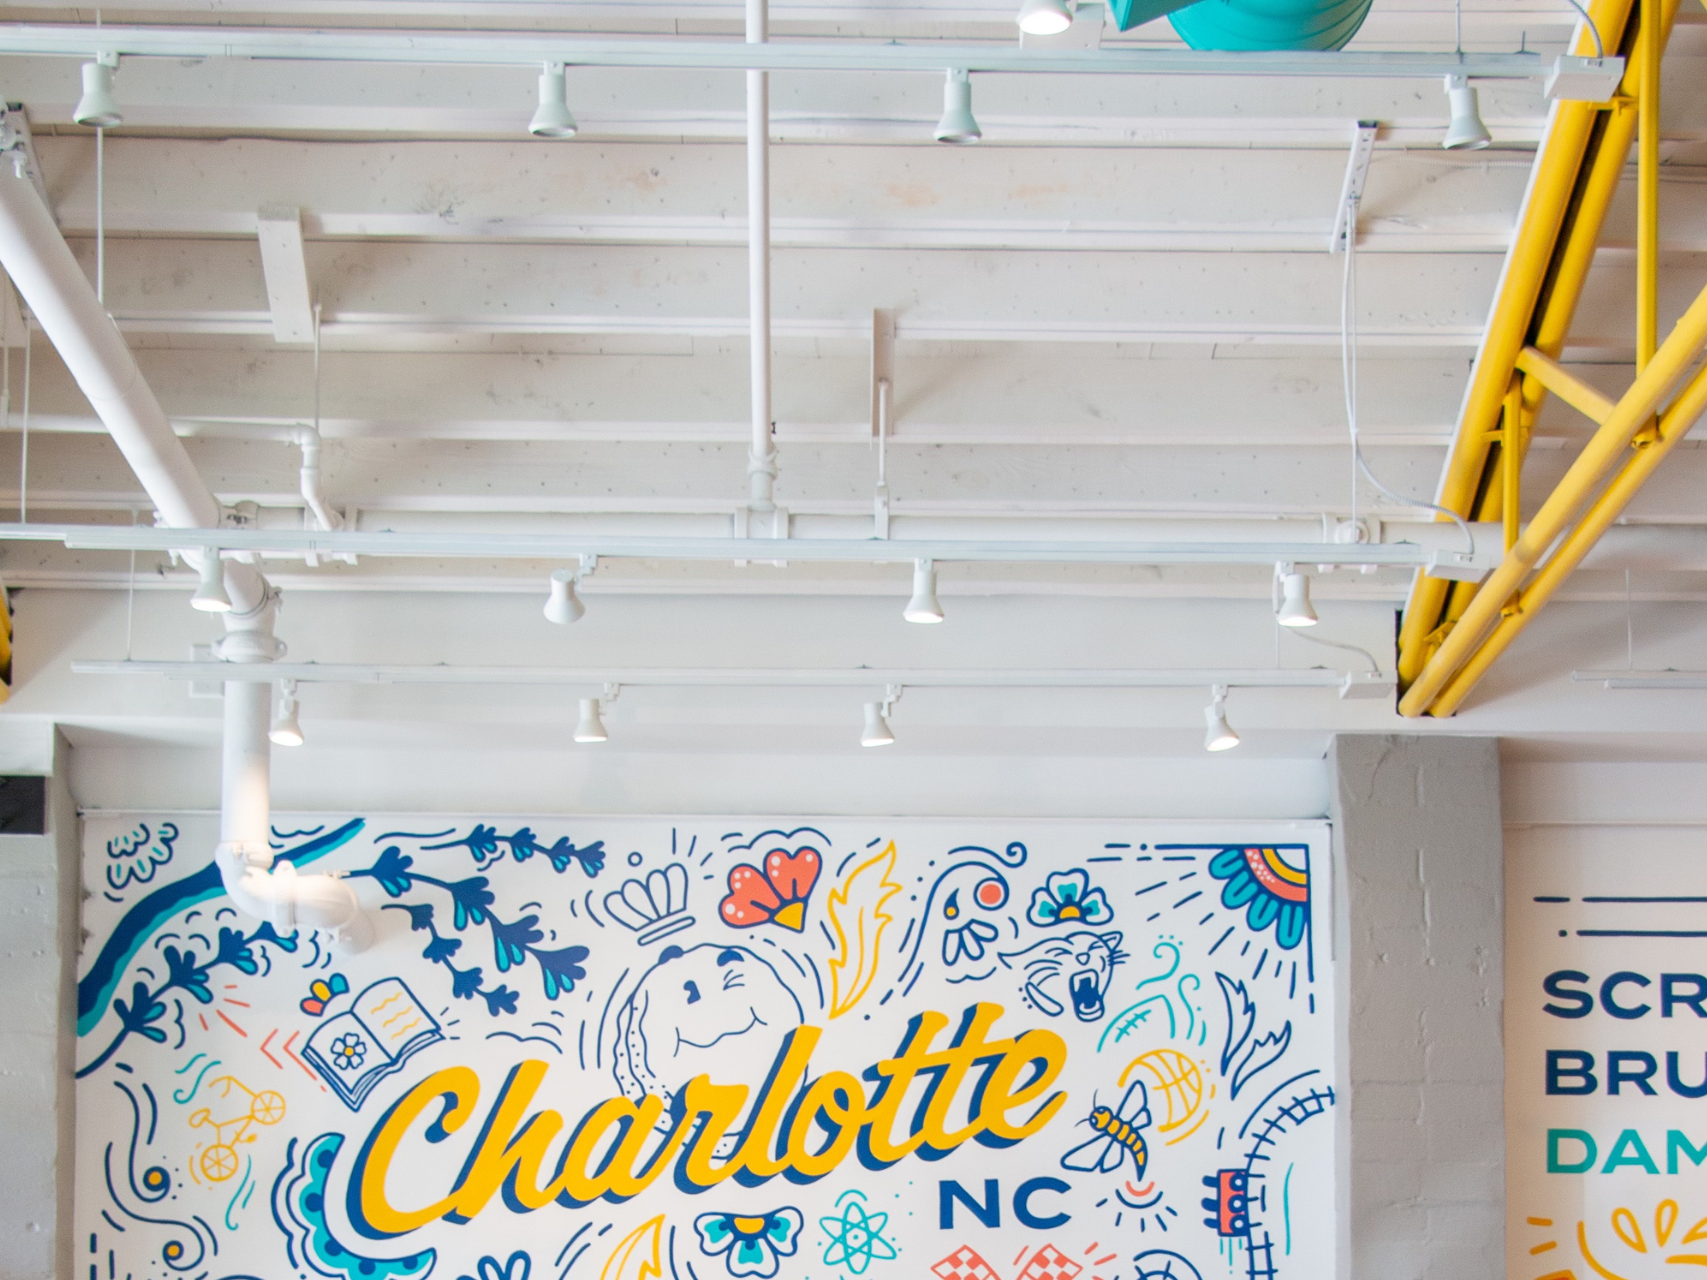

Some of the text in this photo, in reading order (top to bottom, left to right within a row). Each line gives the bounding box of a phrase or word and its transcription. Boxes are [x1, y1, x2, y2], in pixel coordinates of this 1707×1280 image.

[1543, 969, 1707, 1020] SCR
[1546, 1049, 1707, 1098] BRU
[346, 1002, 1068, 1240] Charlotte
[1546, 1128, 1707, 1175] DAM
[939, 1176, 1072, 1230] NC
